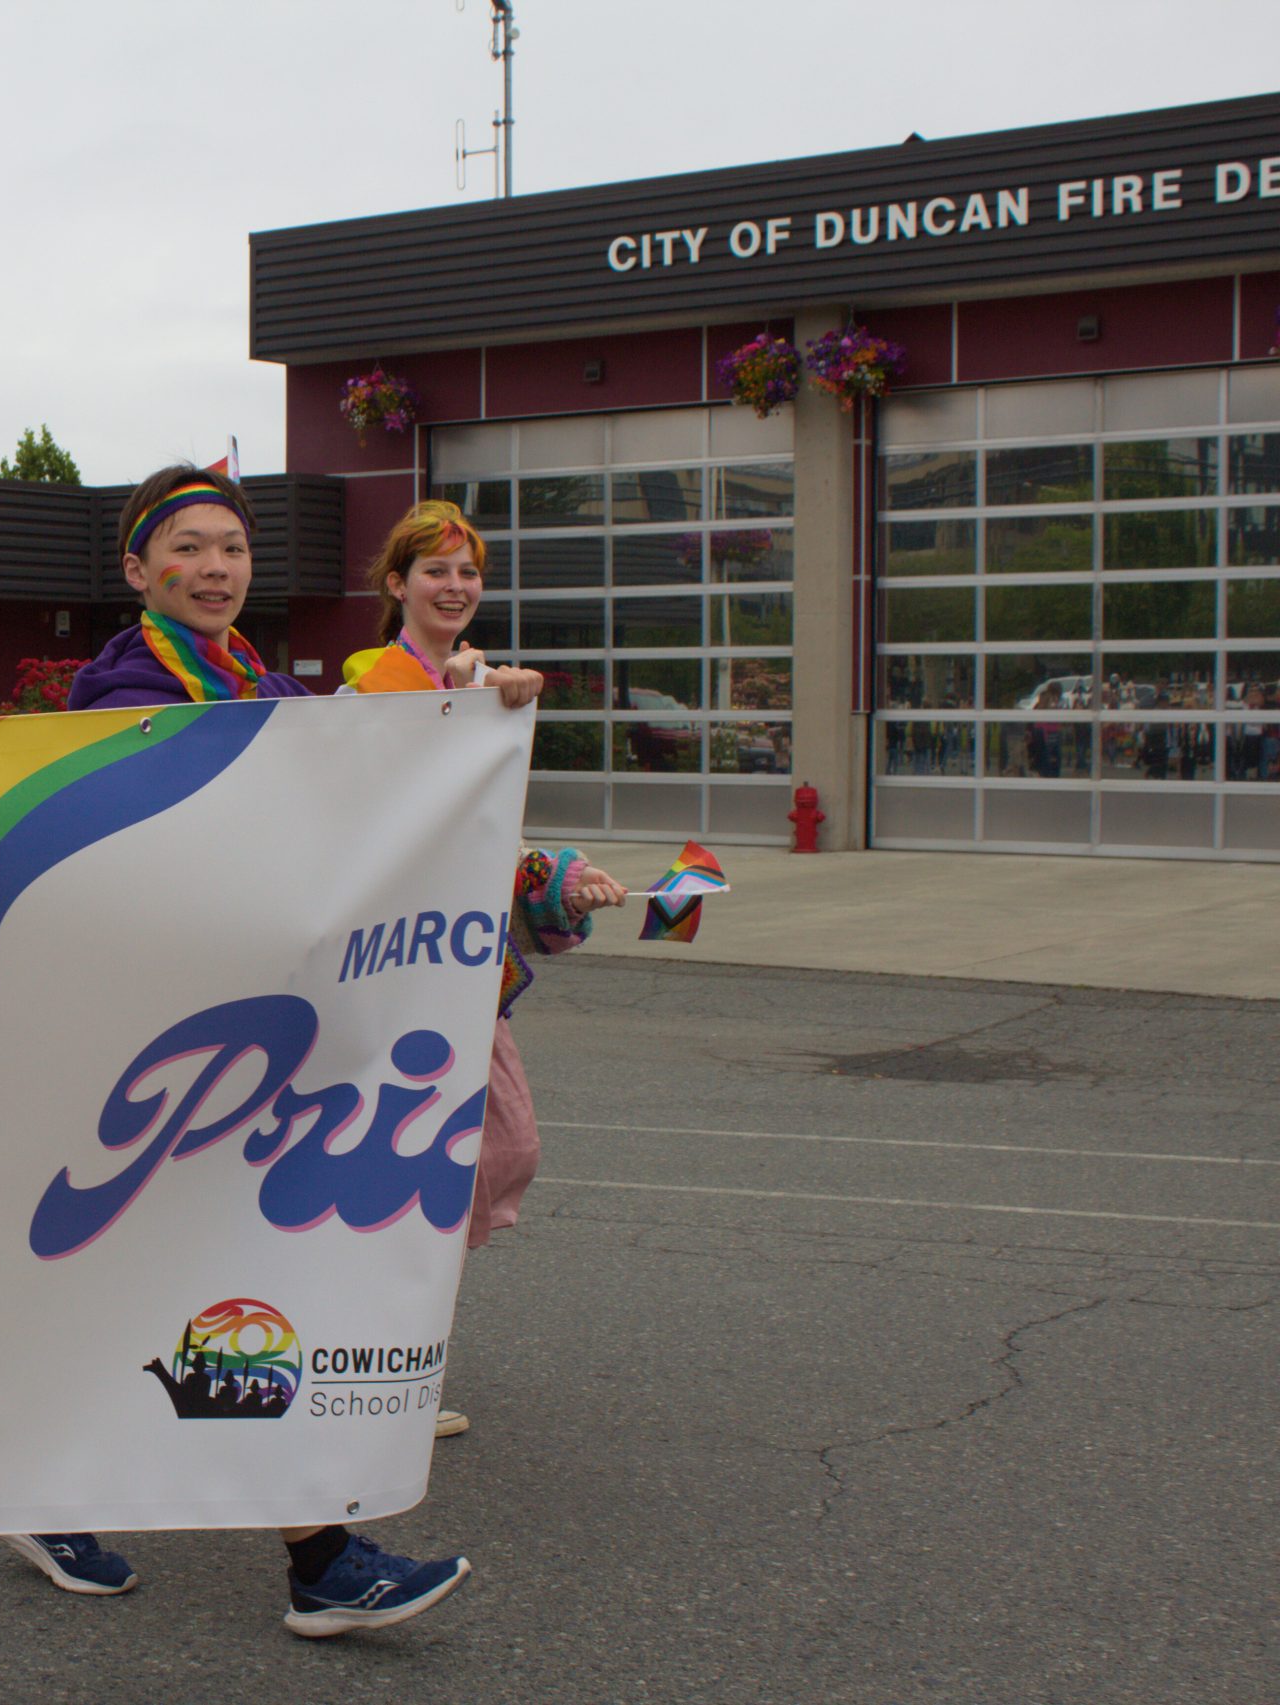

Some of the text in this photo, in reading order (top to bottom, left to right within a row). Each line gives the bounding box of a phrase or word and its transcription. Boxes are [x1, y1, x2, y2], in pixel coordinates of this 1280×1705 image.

[608, 156, 1280, 273] CITY OF DUNCAN FIRE DE
[311, 1340, 445, 1375] COWICHAN
[310, 1388, 409, 1417] School
